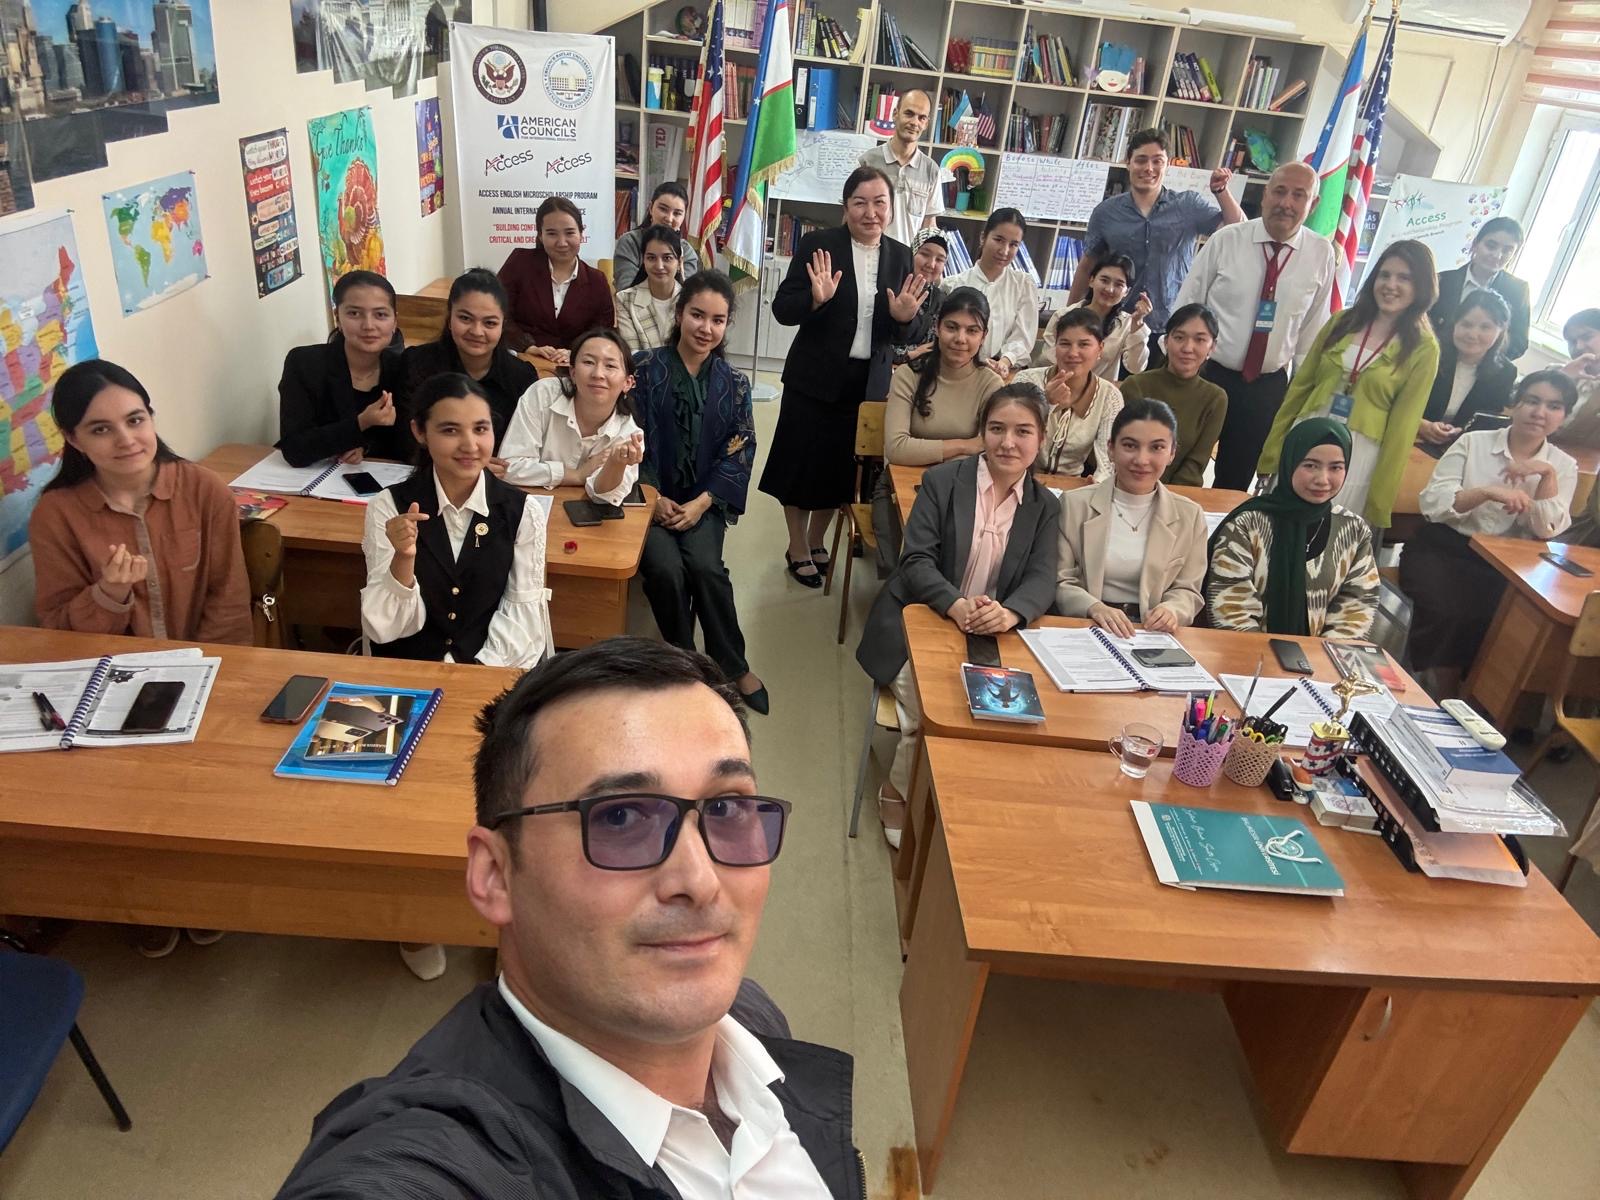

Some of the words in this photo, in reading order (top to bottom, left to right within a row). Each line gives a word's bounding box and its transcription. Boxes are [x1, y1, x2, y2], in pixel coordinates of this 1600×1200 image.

[520, 116, 577, 128] AMERICAN
[520, 126, 577, 138] COUNCILS
[655, 127, 666, 149] TED
[485, 150, 534, 176] Access
[546, 152, 592, 178] Access
[478, 189, 499, 198] ACCESS
[500, 190, 522, 199] ENGLISH
[574, 192, 598, 200] PROGRAM
[492, 206, 513, 215] ANNUAL
[1406, 212, 1447, 227] Access
[489, 235, 512, 244] CRITICAL
[513, 235, 524, 244] AND
